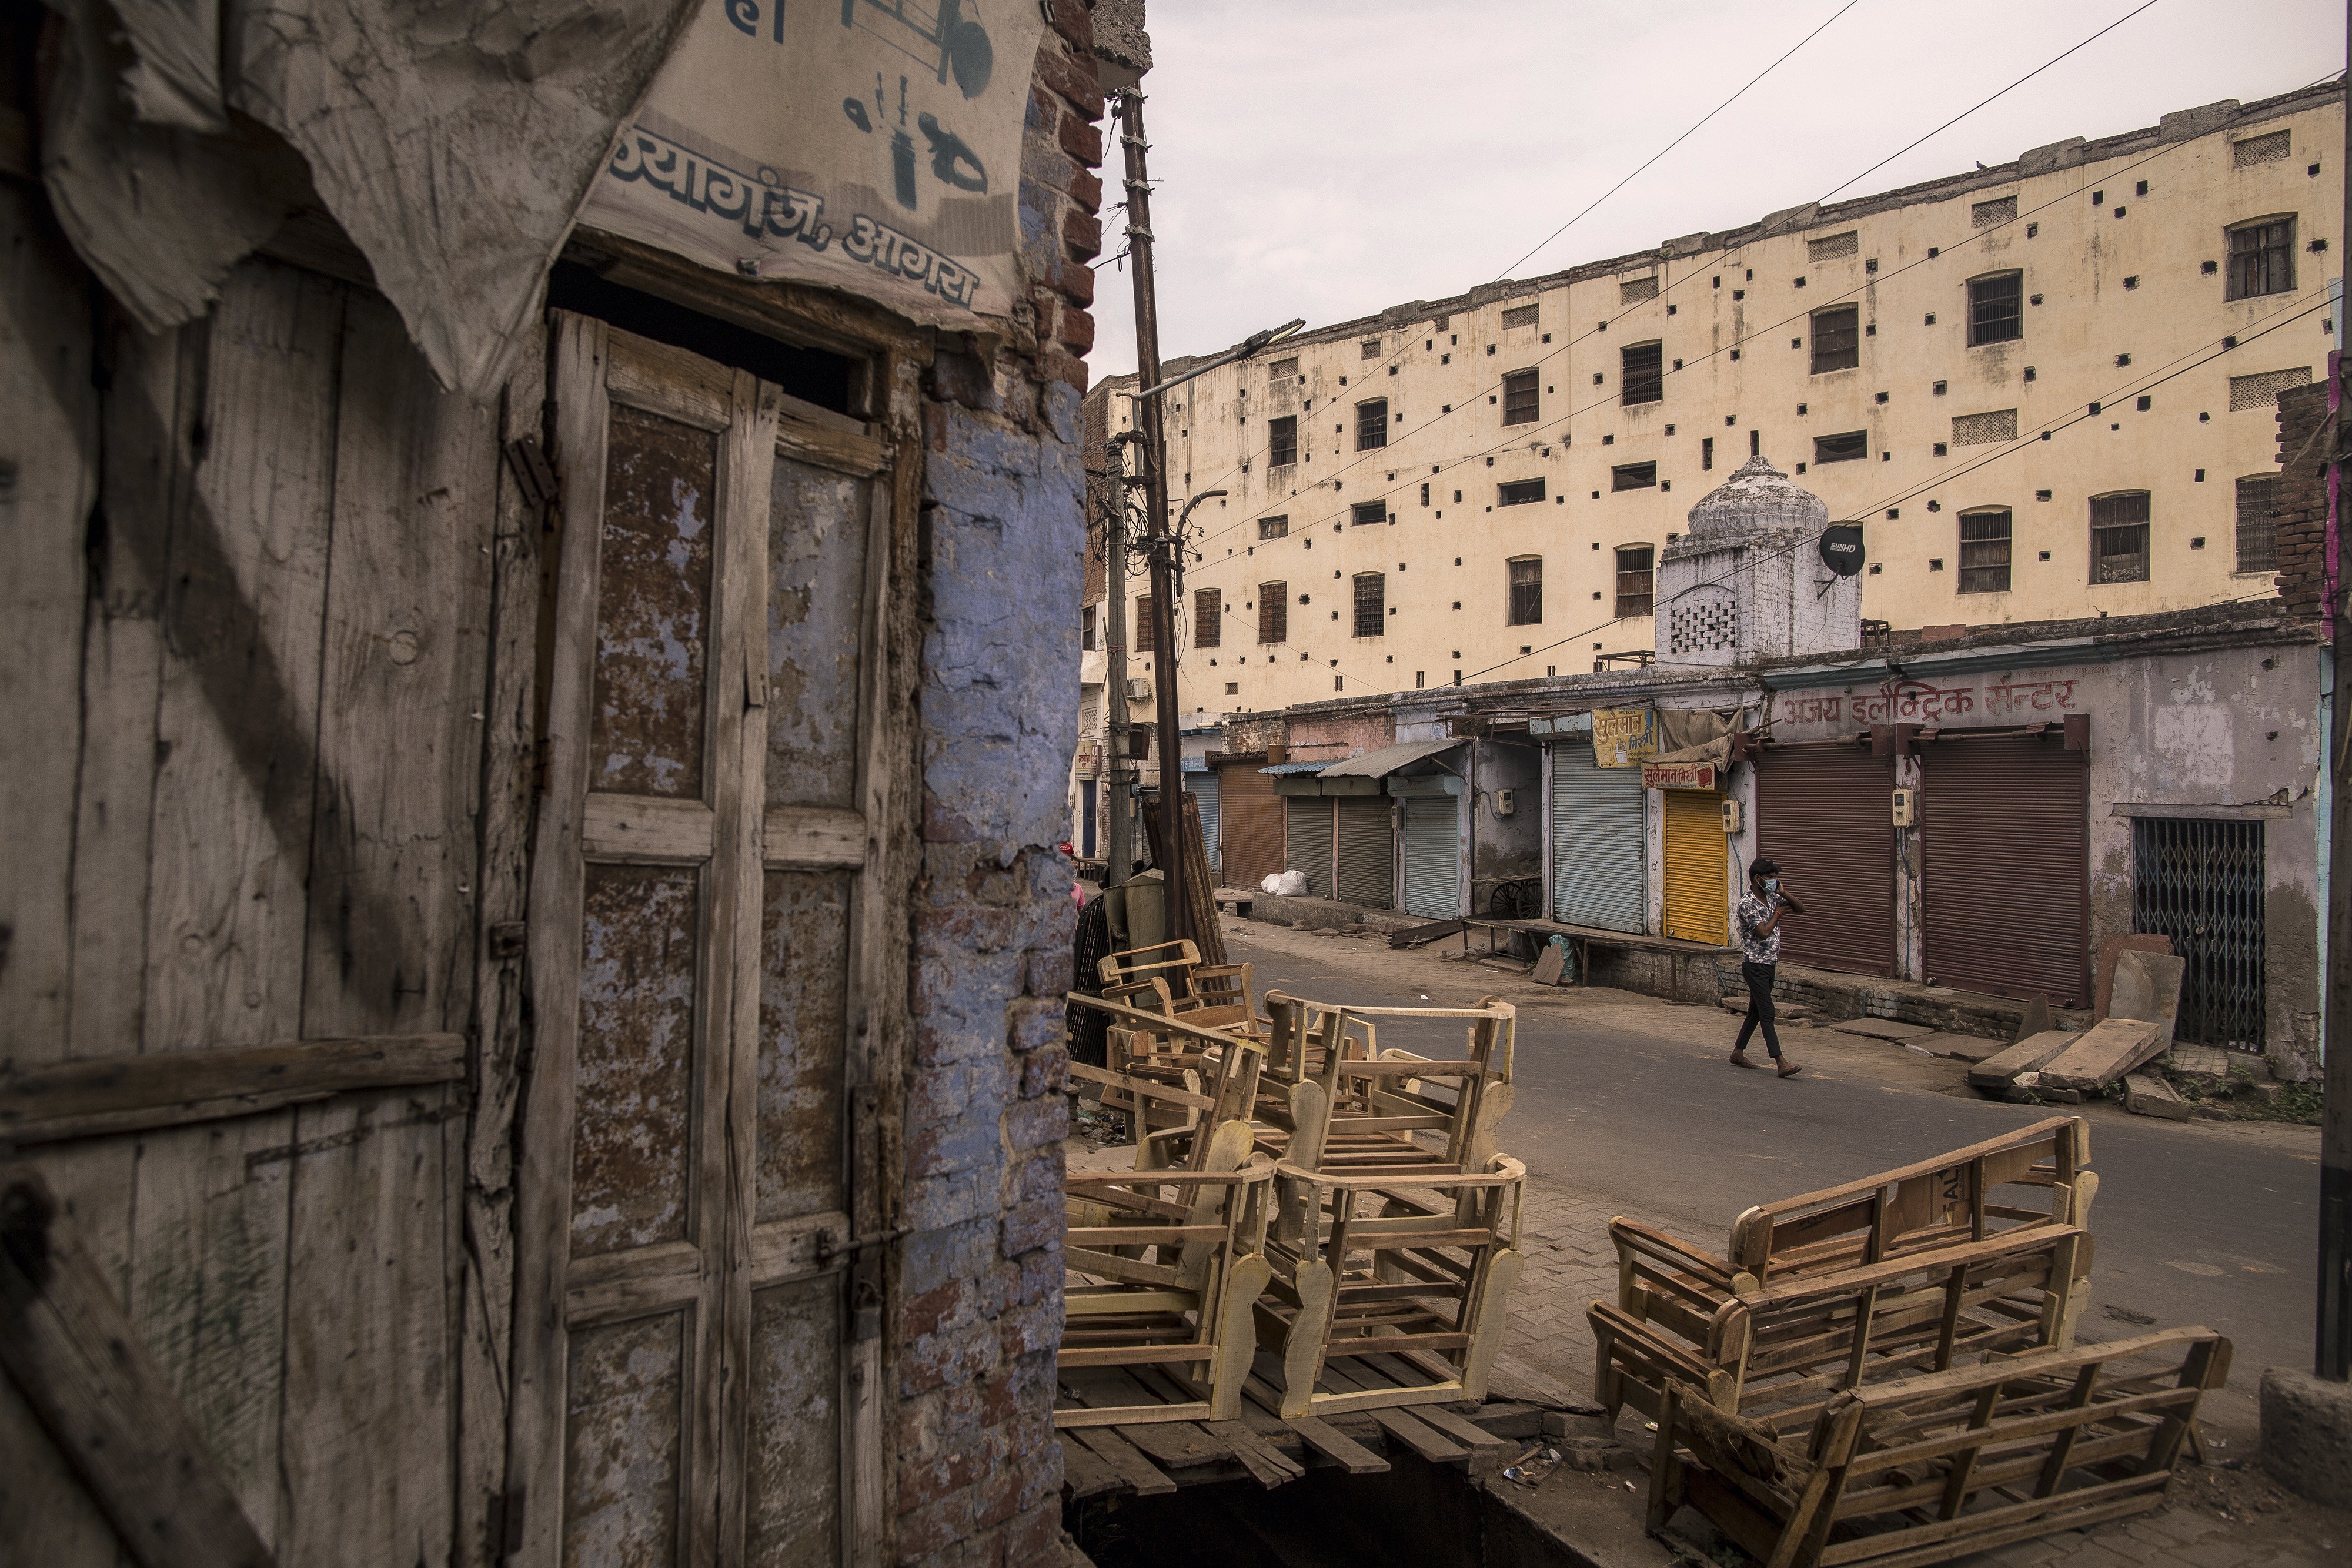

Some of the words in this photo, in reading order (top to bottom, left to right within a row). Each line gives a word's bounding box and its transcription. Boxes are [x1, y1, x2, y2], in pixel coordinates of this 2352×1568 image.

[841, 213, 980, 310] आगरा
[1842, 544, 1856, 553] HD
[1784, 697, 1843, 726] अजय
[1984, 677, 2079, 715] सेन्टर
[1644, 764, 1677, 787] सुलेमान
